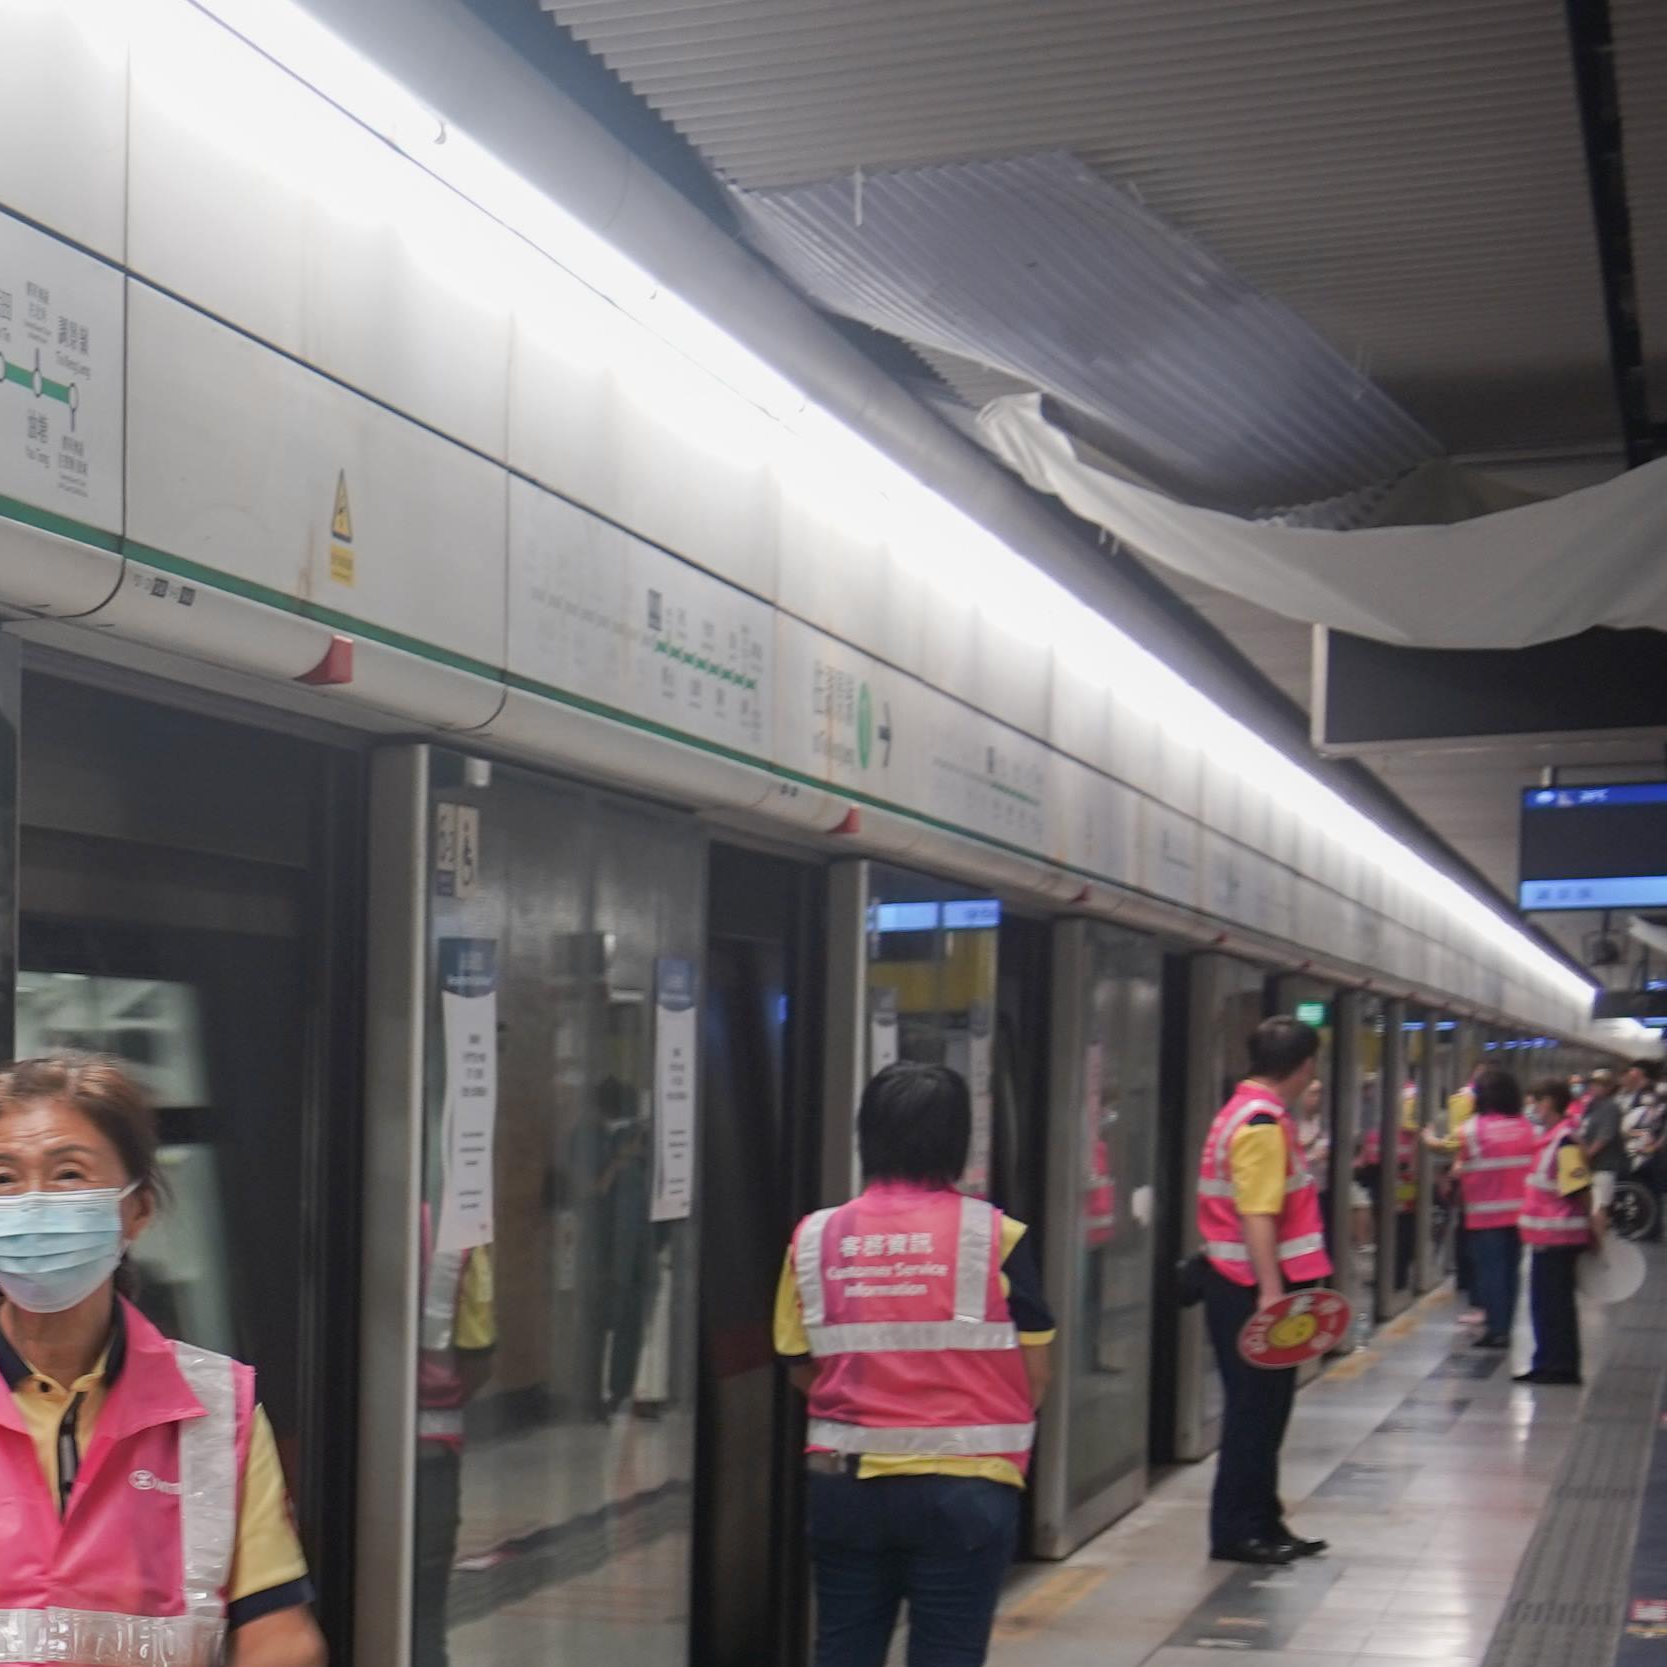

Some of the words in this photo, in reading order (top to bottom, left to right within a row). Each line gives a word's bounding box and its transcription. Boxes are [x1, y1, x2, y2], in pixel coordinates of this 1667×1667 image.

[826, 1264, 892, 1282] Customer
[893, 1260, 948, 1278] Service
[843, 1281, 928, 1298] Information
